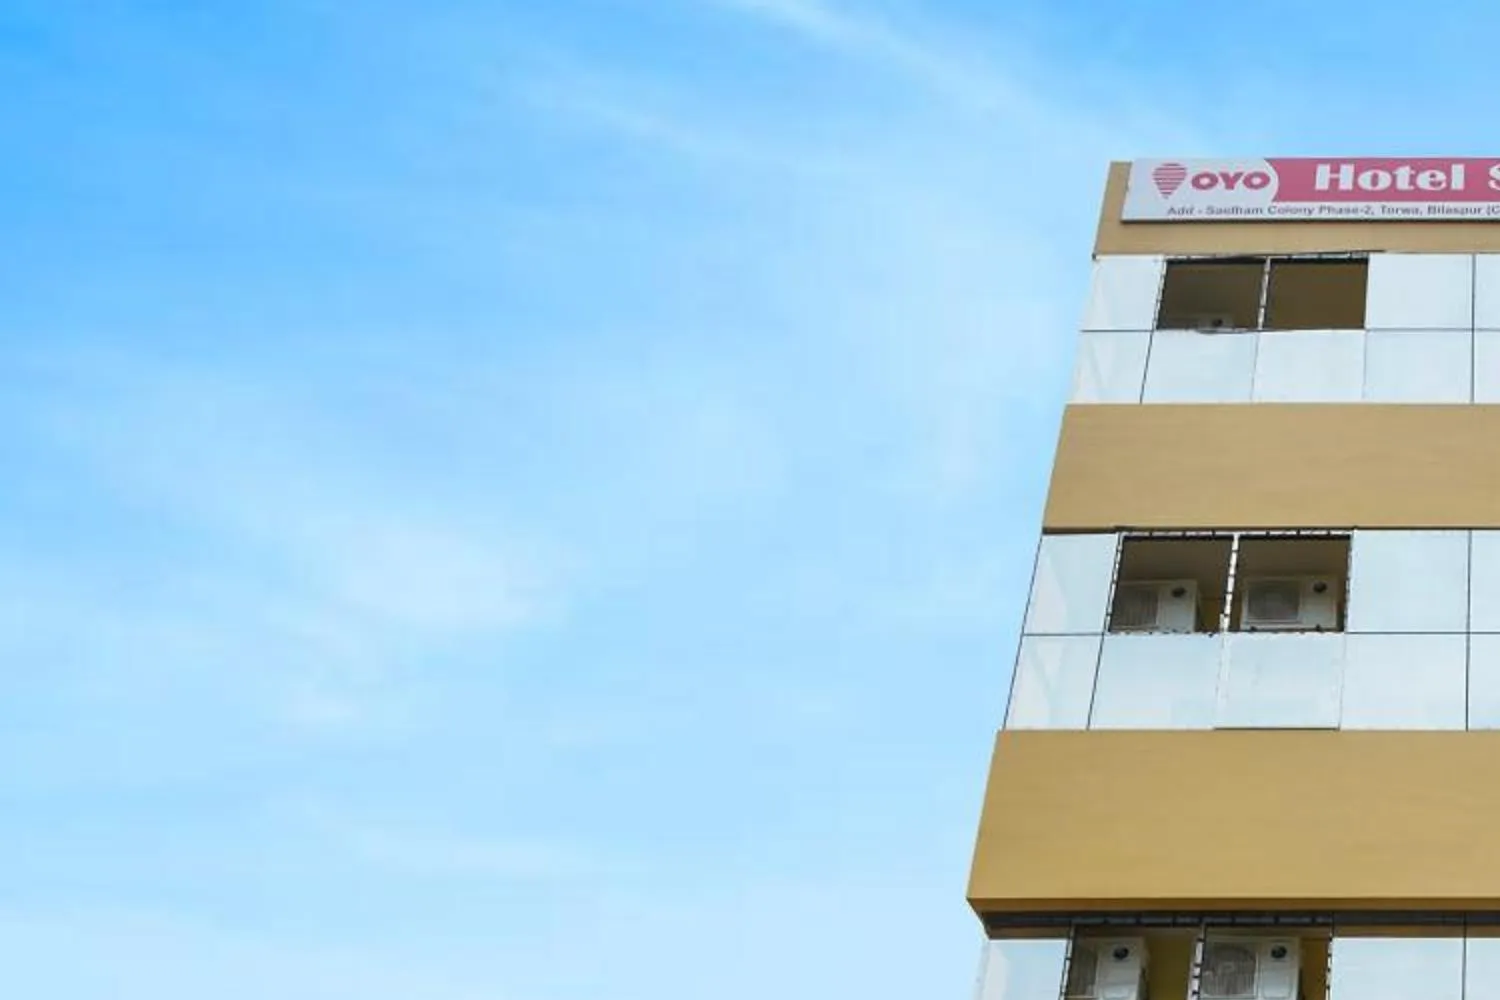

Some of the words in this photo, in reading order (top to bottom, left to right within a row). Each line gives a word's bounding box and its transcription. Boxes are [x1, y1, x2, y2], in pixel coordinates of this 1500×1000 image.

[1191, 170, 1271, 191] OYO
[1314, 163, 1466, 192] Hotel
[1167, 205, 1194, 216] Add
[1267, 205, 1314, 217] Colony
[1427, 205, 1482, 217] Bilaspur
